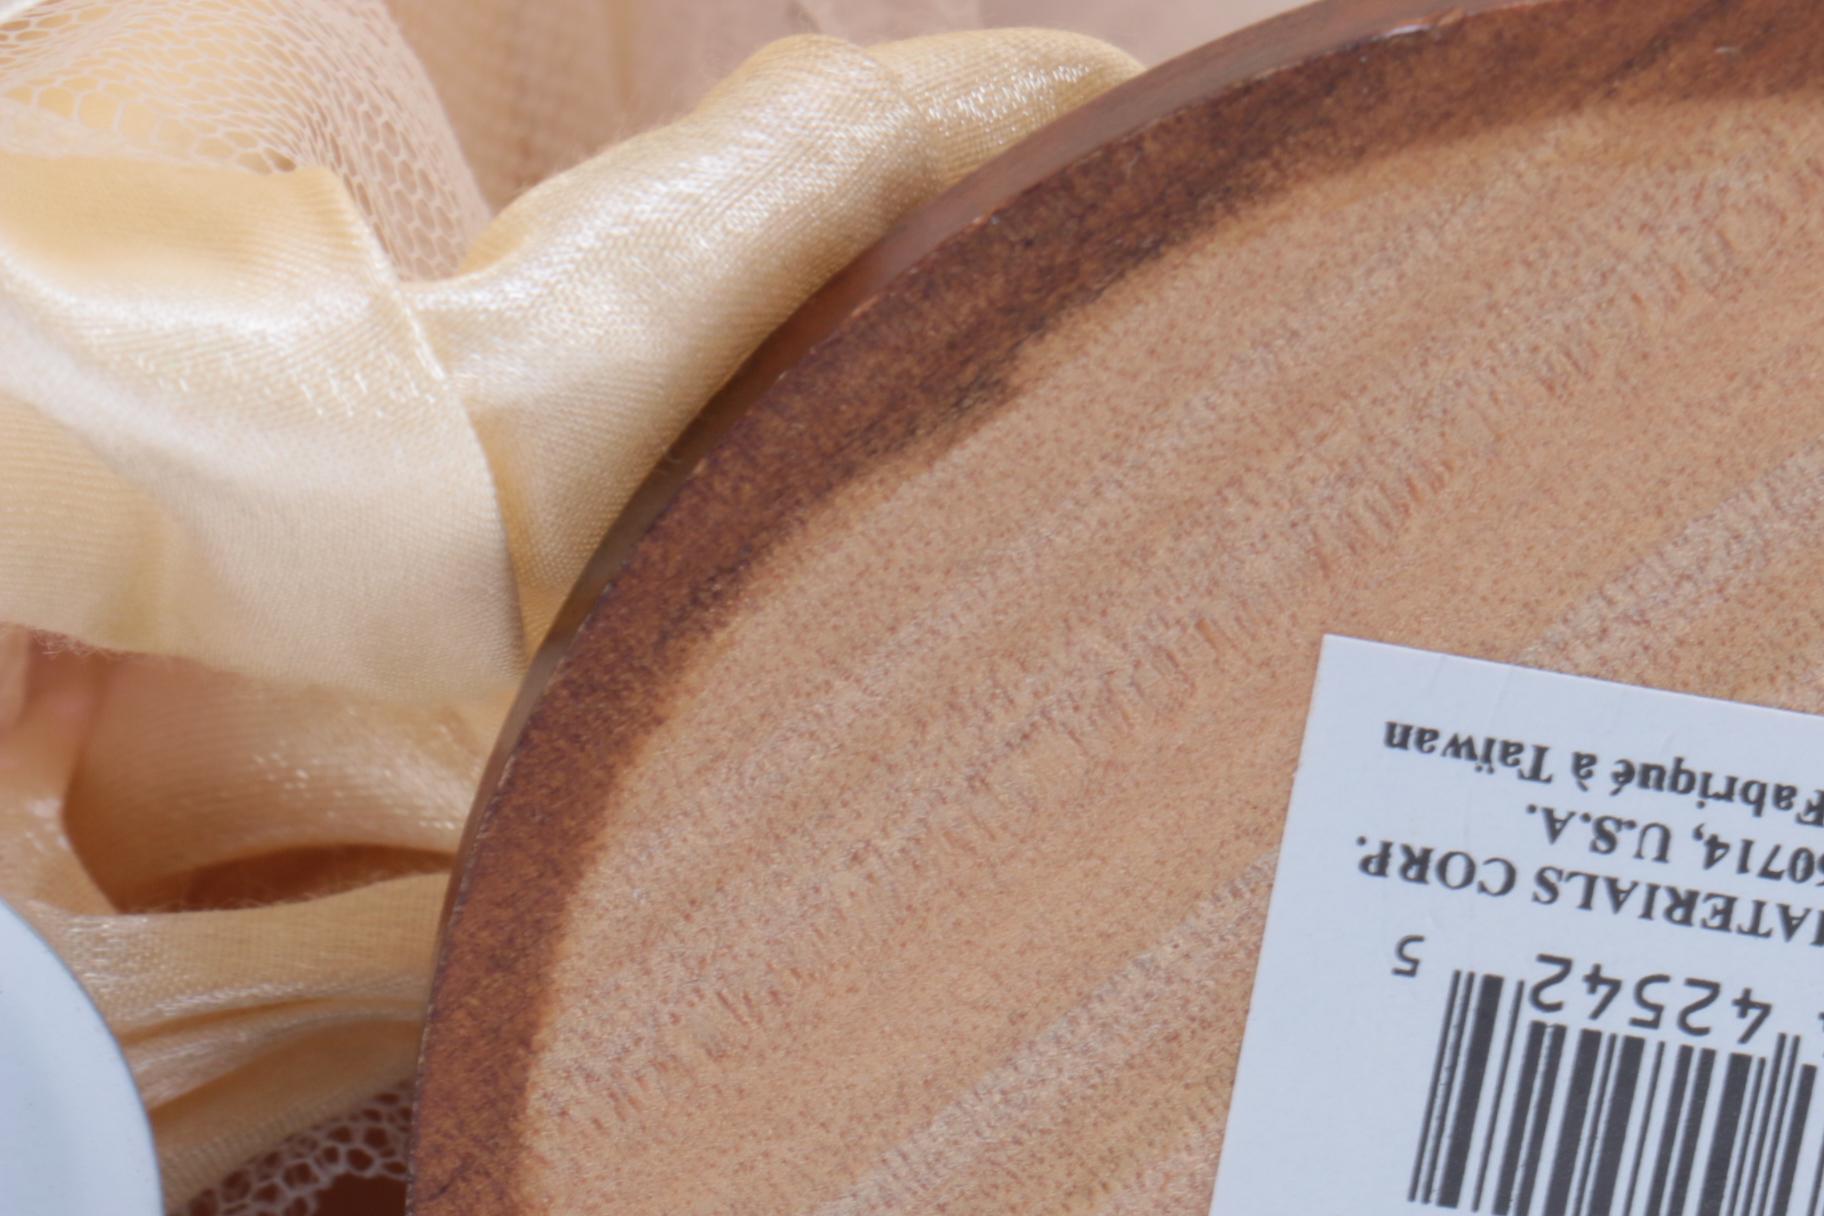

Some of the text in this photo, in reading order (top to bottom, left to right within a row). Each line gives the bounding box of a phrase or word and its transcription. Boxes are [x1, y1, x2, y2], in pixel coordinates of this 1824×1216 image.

[1382, 719, 1554, 785] Taïwan
[1569, 749, 1599, 793] à
[1525, 802, 1673, 865] U.S.A.
[1355, 834, 1518, 898] CORP.
[1390, 933, 1426, 979] 5
[1526, 951, 1774, 1046] 42542
